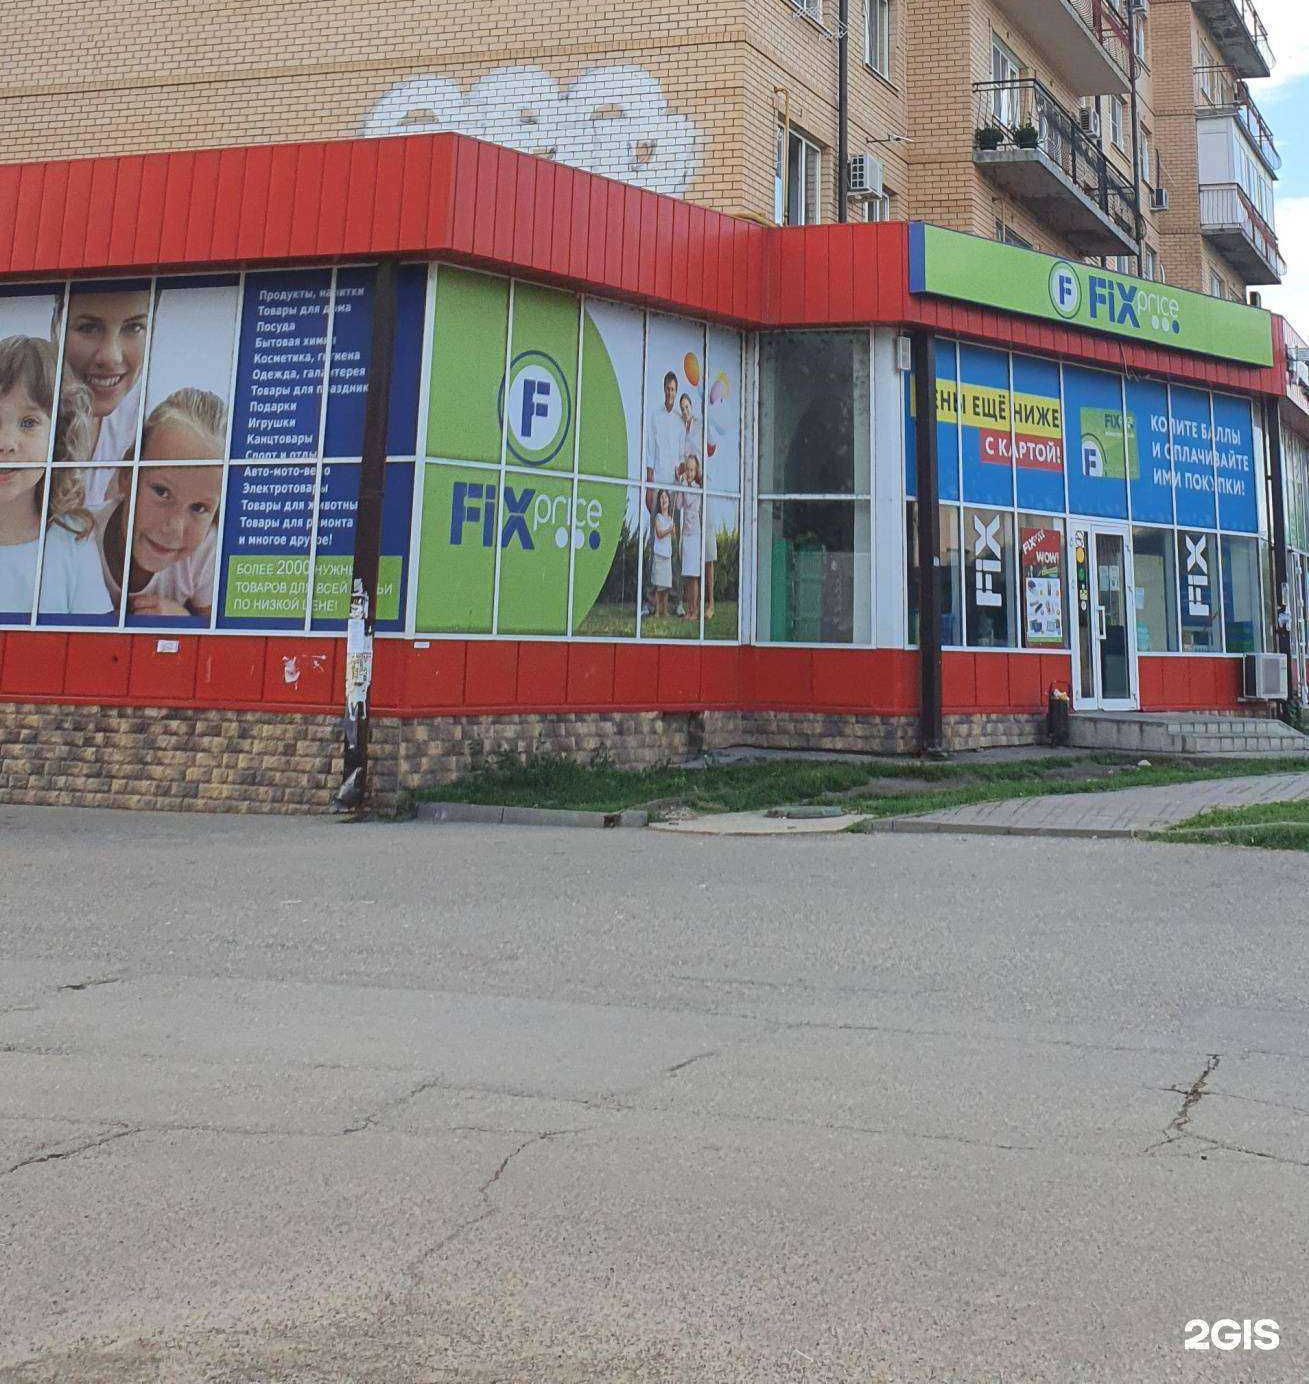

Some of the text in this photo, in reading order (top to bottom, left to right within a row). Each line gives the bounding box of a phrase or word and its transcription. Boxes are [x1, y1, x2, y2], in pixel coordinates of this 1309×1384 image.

[259, 287, 365, 302] Продукты, наитки
[258, 303, 352, 317] Товары для дма
[1137, 290, 1180, 318] price
[256, 321, 296, 334] Посуда
[255, 337, 301, 348] Бытовая
[254, 352, 315, 364] Косметика,
[252, 368, 300, 381] Одежда,
[251, 383, 370, 398] Товары для паздник
[250, 401, 297, 414] Подарки
[972, 394, 1007, 422] ЕЩЁ
[1013, 402, 1060, 429] НИЖЕ
[248, 417, 296, 429] Игрушки
[1150, 414, 1199, 438] КОПИТЕ
[247, 433, 313, 447] Канцтовары
[289, 451, 318, 460] отды
[998, 438, 1061, 464] КАРТОЙ!
[1152, 441, 1161, 459] И
[244, 466, 331, 477] Авто-мото-вео
[1153, 467, 1182, 488] ИМИ
[241, 499, 359, 513] Товары для жвотны
[533, 493, 603, 531] price
[240, 516, 354, 530] Товары для рмонта
[238, 534, 333, 547] и многое друое!
[236, 562, 275, 575] БОЛЕЕ
[315, 564, 353, 576] НУЖН
[235, 581, 287, 593] ТОВАРОВ
[316, 580, 349, 594] ВСЕЙ
[233, 599, 251, 610] ПО
[253, 596, 300, 610] НИЗКОЙ
